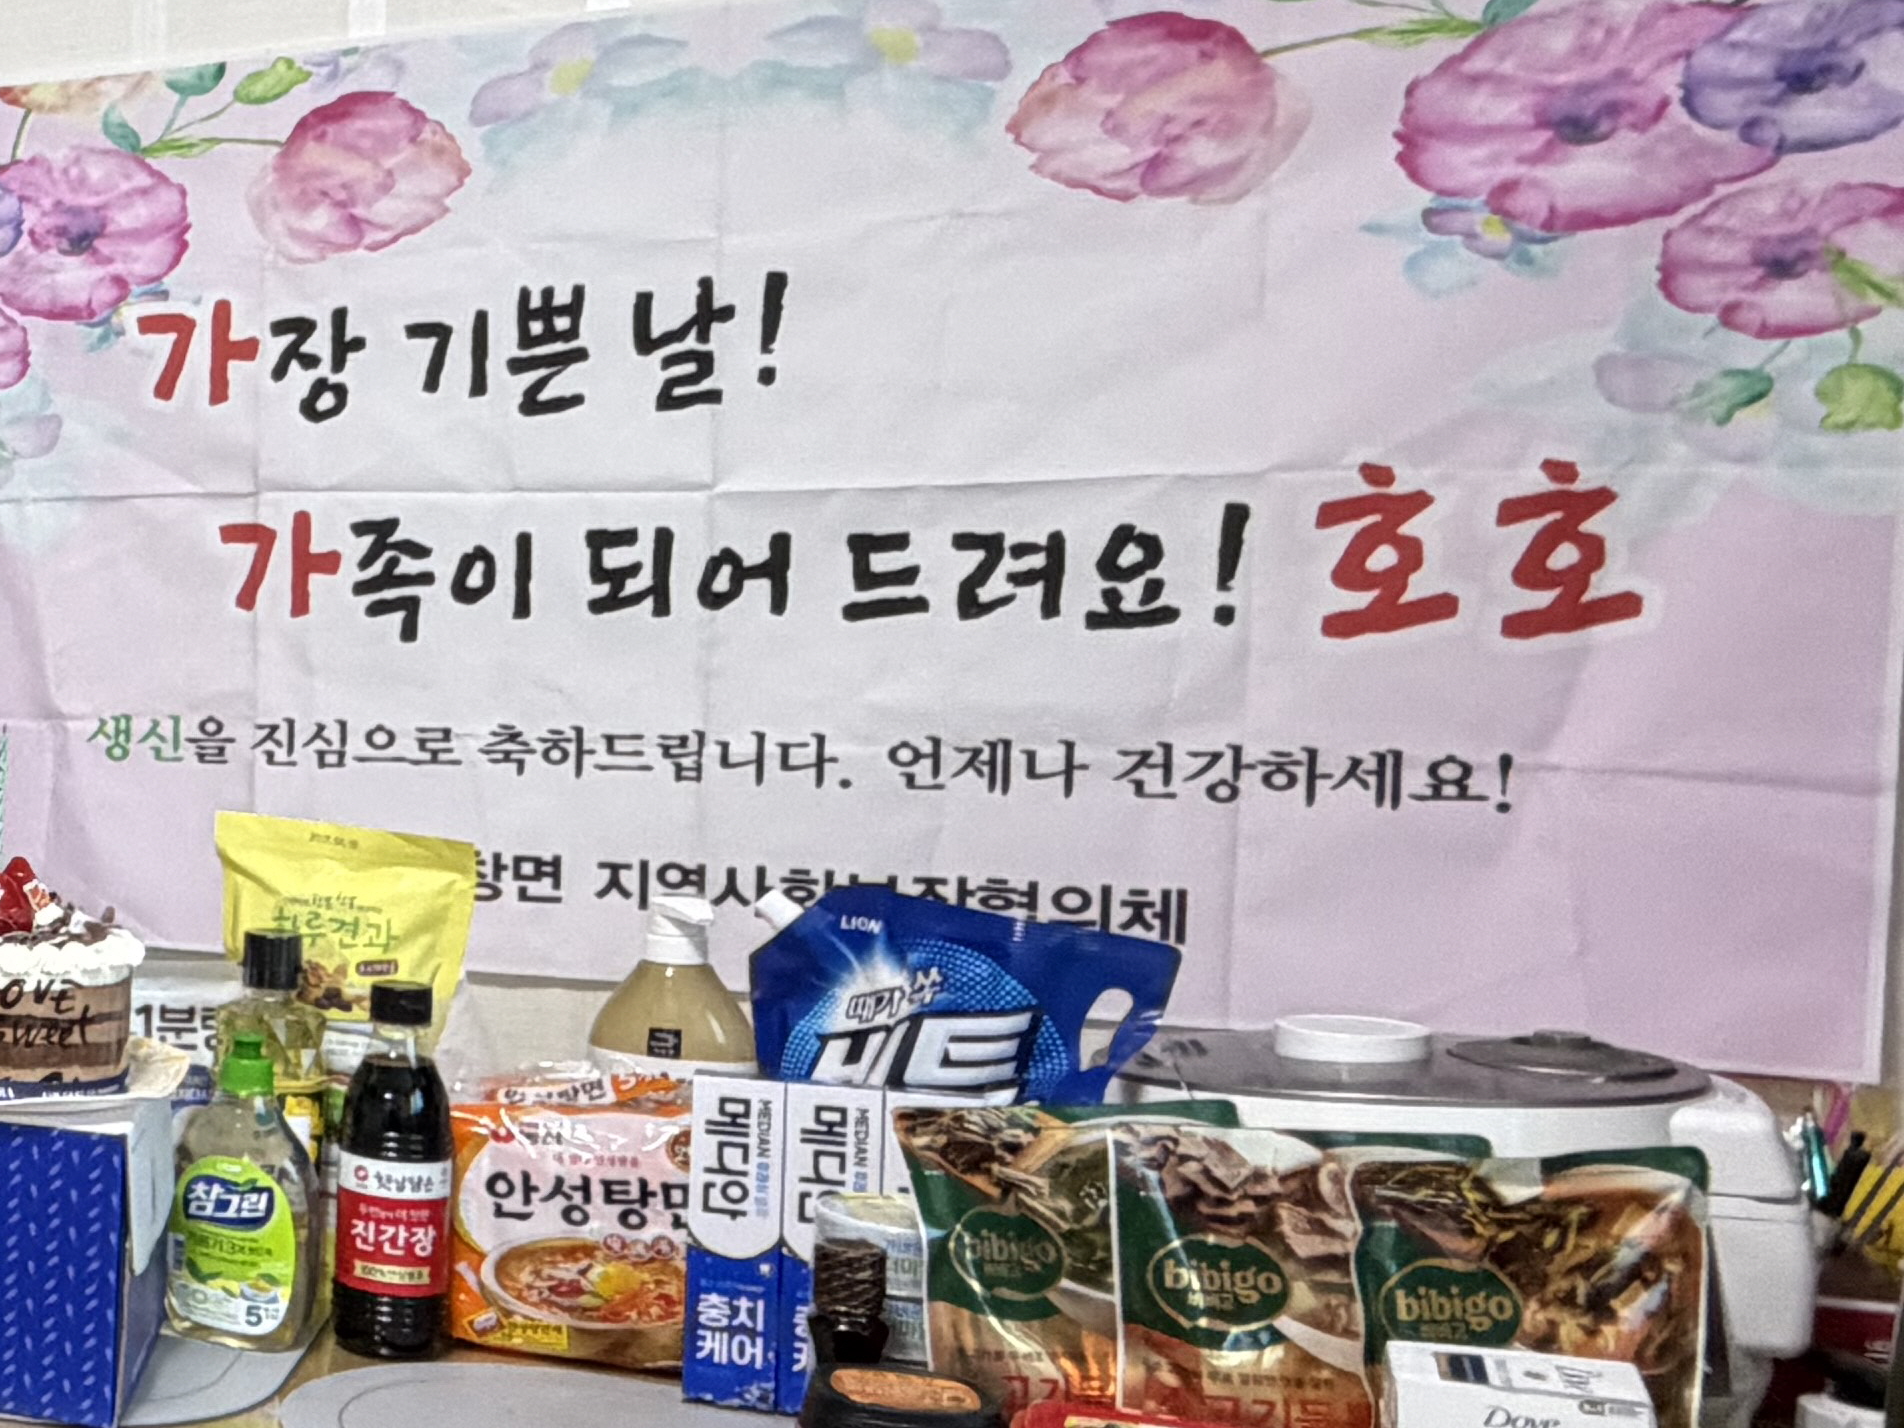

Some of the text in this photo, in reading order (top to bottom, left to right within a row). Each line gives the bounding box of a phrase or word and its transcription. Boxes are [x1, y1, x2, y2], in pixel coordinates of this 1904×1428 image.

[136, 270, 789, 424] 가장 기쁜 날!
[218, 458, 1644, 644] 가족이 되어 드려요! 호호
[86, 713, 1516, 814] 생신을 진심으로 축하드립니다. 언제나 건강하세요!
[840, 915, 883, 934] LION
[754, 1098, 773, 1159] MEDIAN
[852, 1107, 870, 1168] MEDIAN
[701, 1096, 752, 1221] 메디안
[187, 1180, 269, 1218] 참그린
[350, 1219, 437, 1258] 진간장
[968, 1228, 1058, 1272] bibigo
[1163, 1258, 1283, 1308] bibigo
[696, 1293, 766, 1332] 충치
[1396, 1287, 1515, 1334] bibigo
[695, 1330, 764, 1370] 케어
